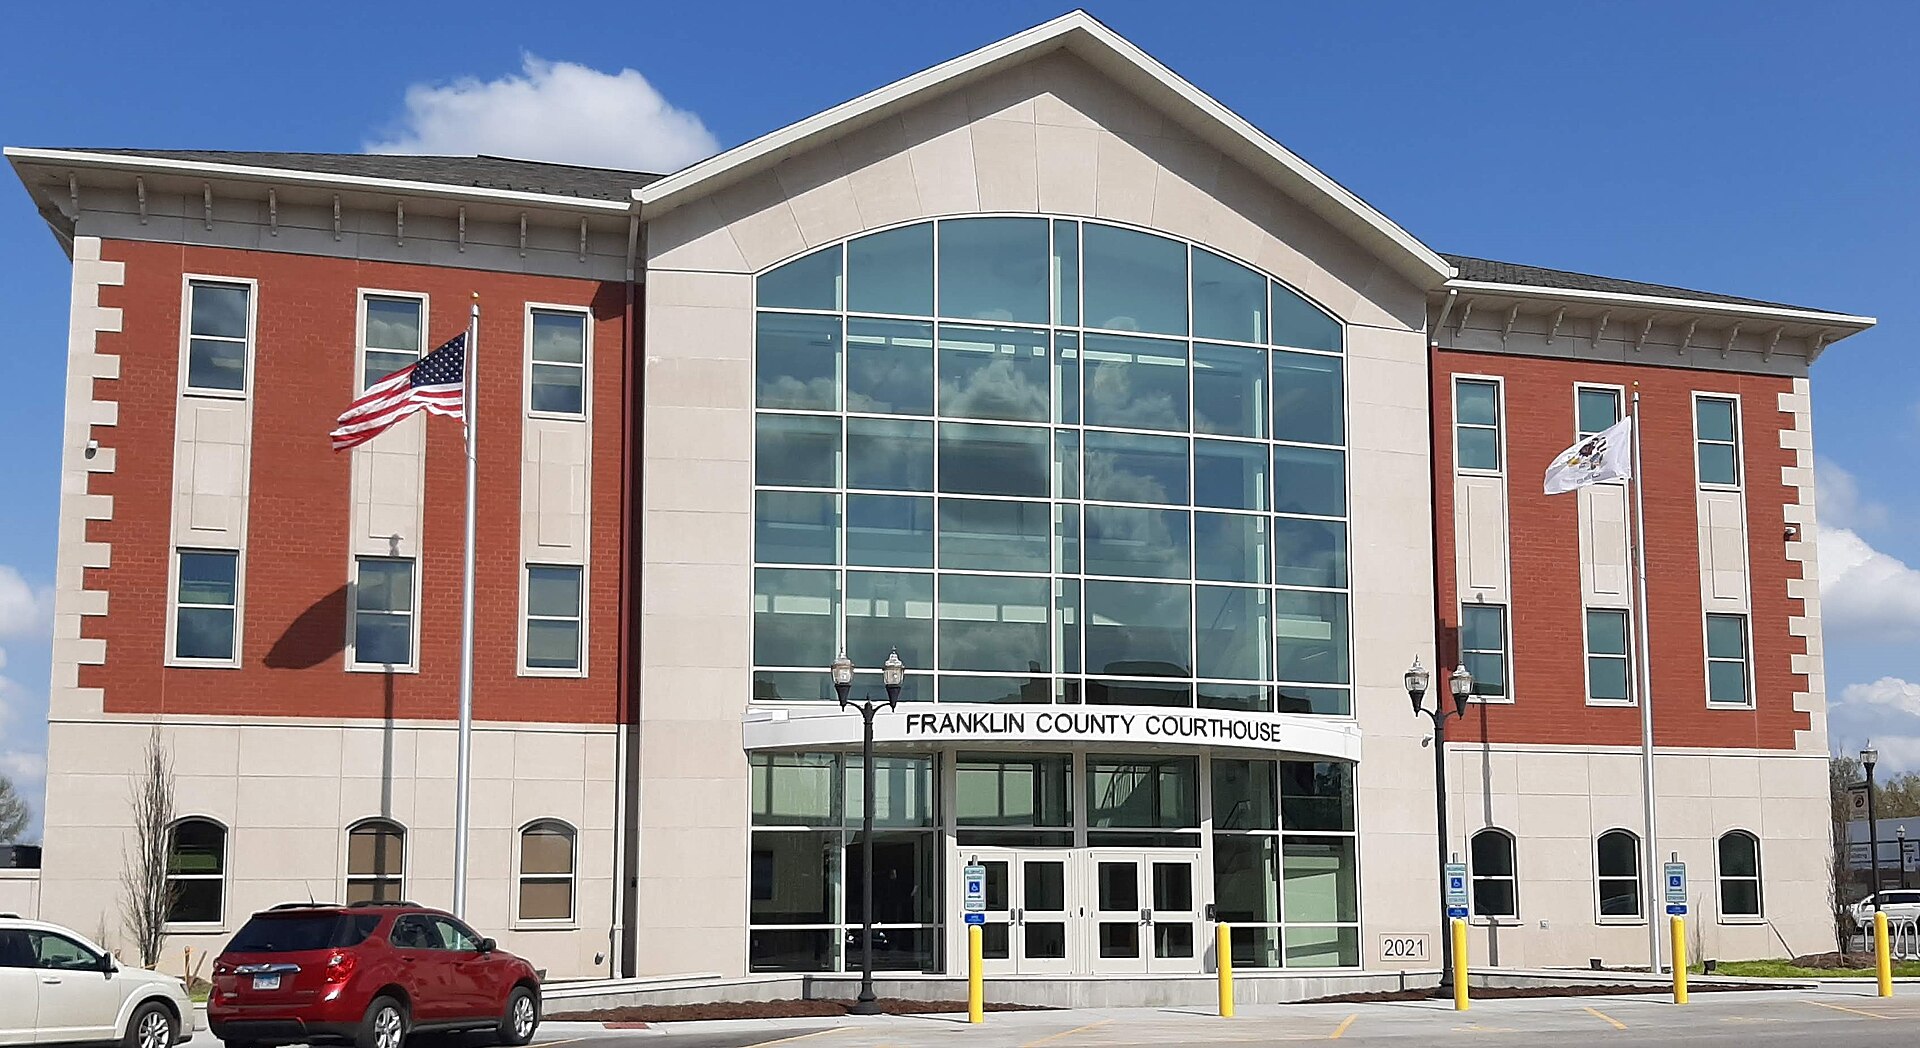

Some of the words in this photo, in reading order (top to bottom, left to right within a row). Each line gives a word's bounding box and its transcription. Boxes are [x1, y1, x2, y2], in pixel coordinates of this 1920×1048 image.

[906, 712, 1025, 734] FRANKLIN
[1036, 713, 1135, 734] COUNTY
[1145, 715, 1281, 742] COURTHOUSE
[1384, 938, 1423, 957] 2021
